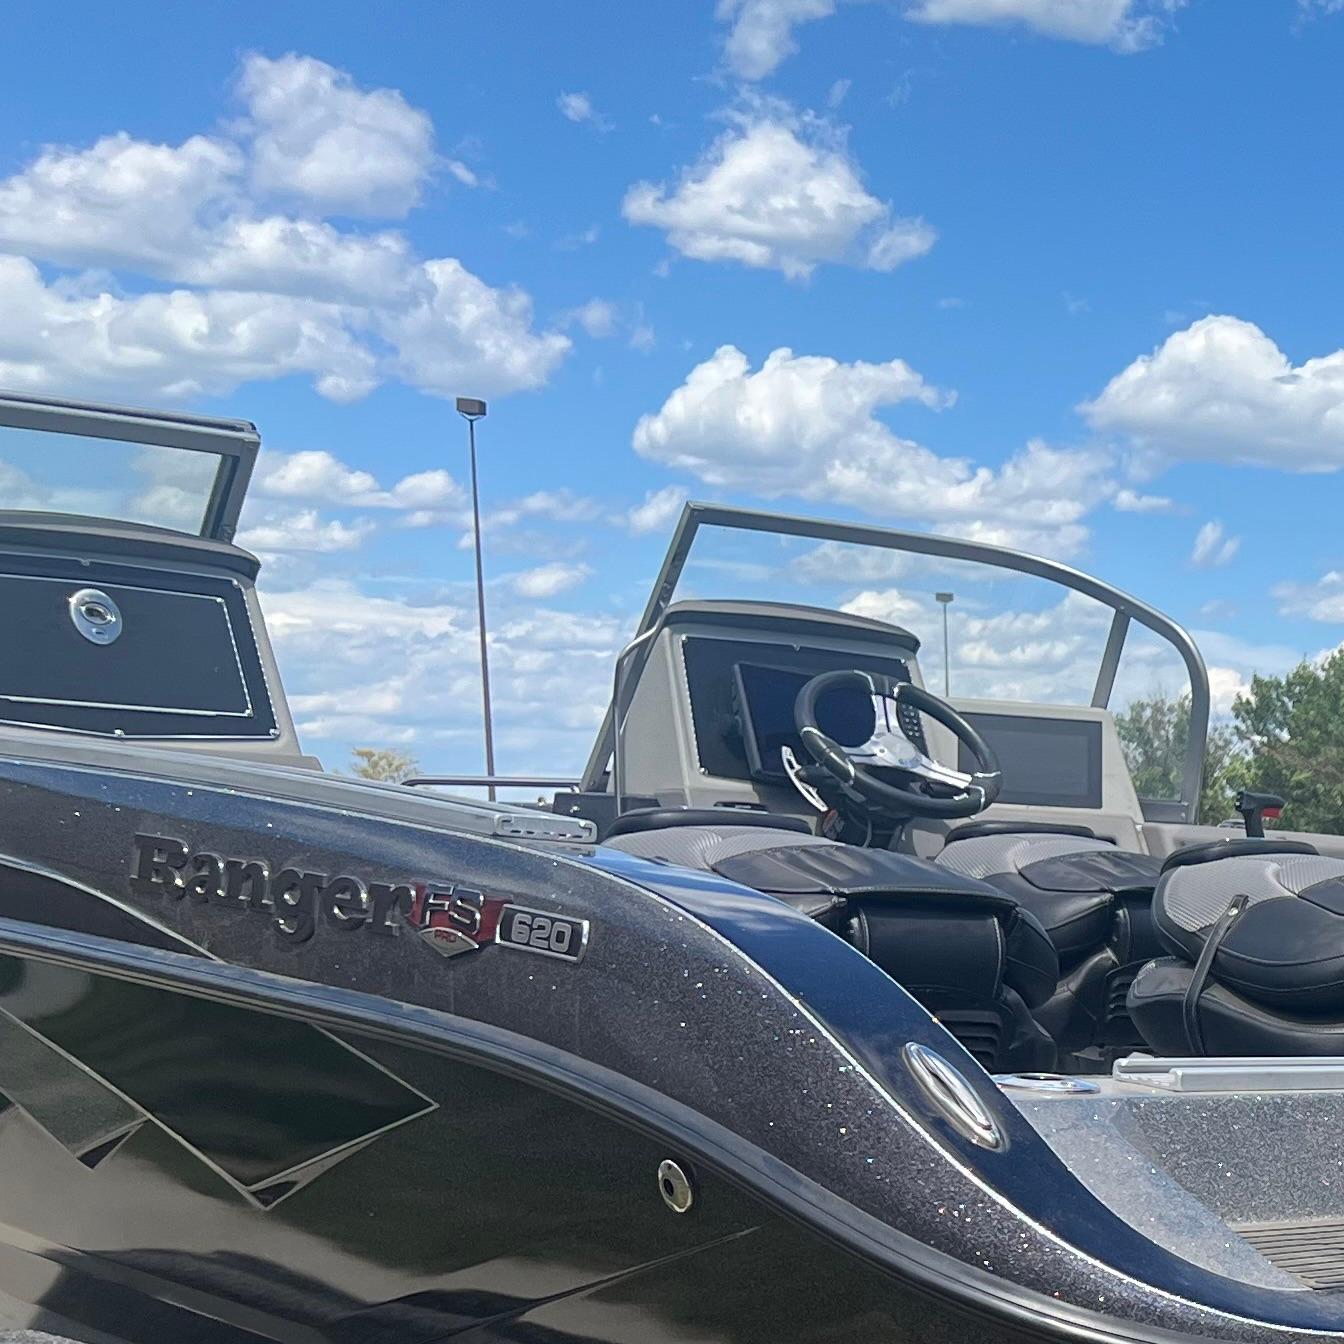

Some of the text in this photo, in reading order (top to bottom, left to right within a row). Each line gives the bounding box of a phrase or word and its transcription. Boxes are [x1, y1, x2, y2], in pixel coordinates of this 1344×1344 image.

[129, 832, 417, 943] Ranger
[420, 881, 573, 953] FS 620
[434, 929, 457, 944] PRO
